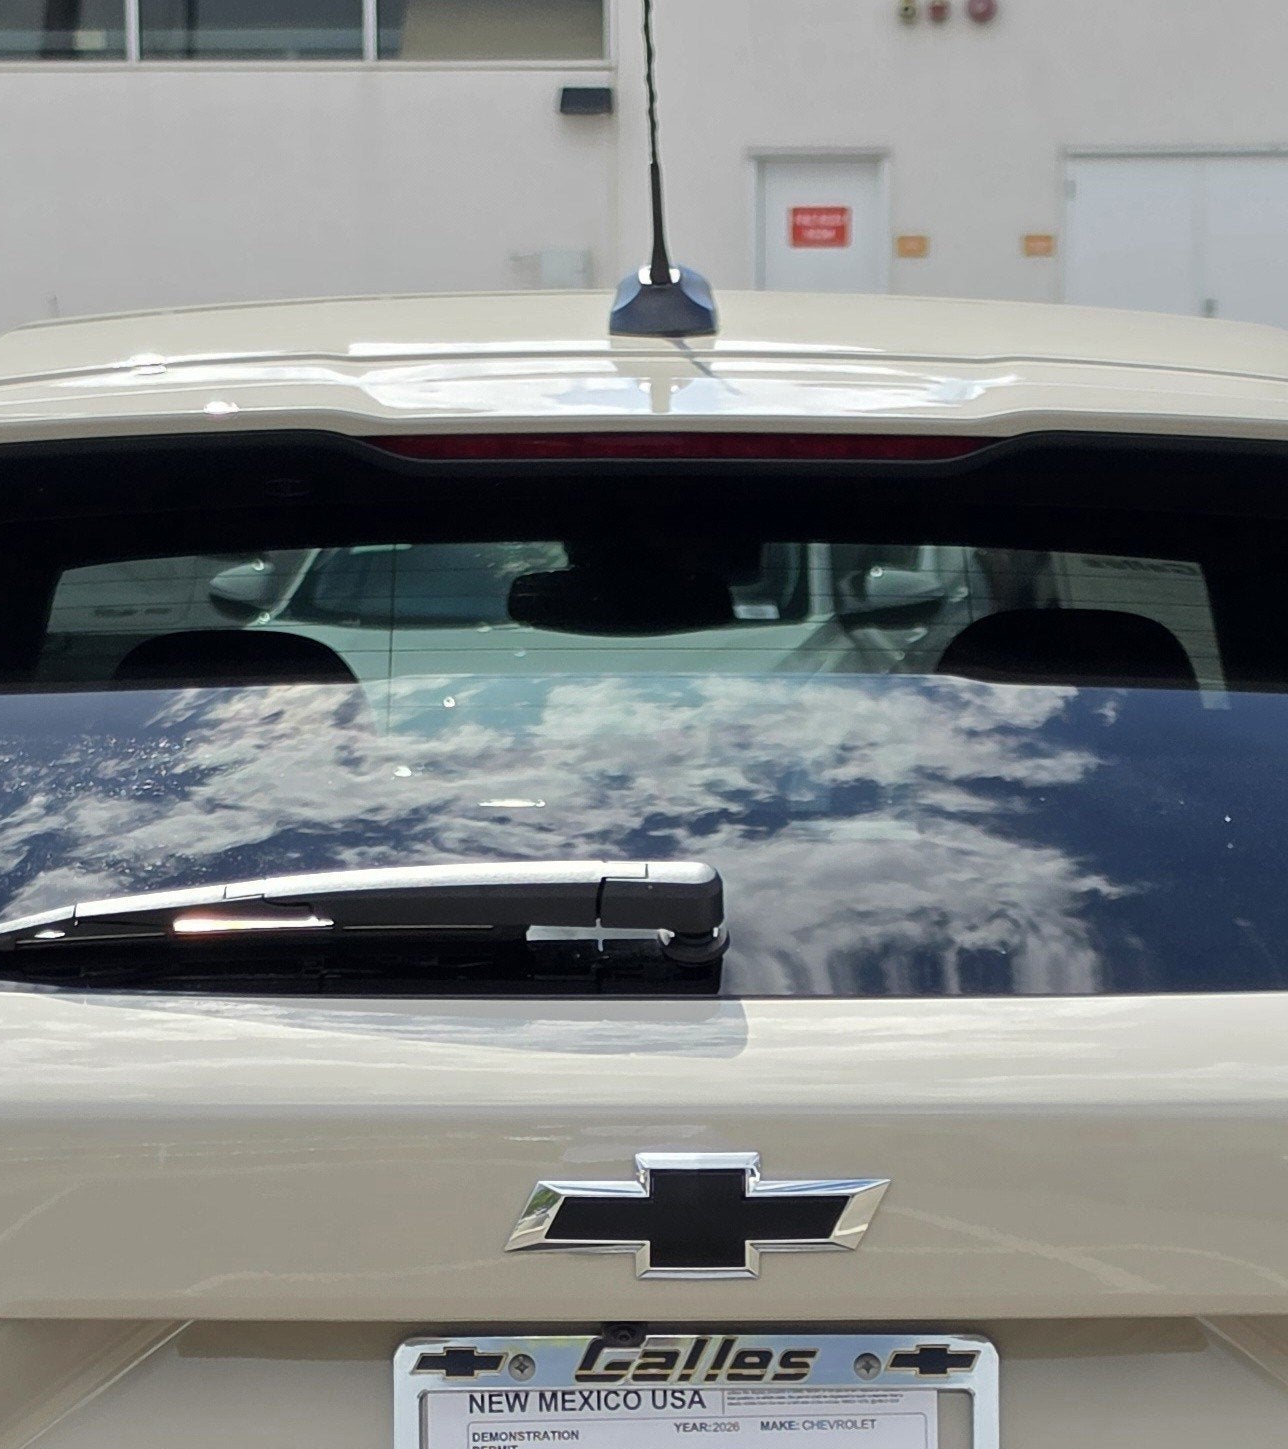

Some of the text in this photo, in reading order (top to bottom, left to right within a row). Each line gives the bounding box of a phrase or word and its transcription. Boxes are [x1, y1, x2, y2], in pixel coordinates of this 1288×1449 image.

[574, 1336, 819, 1383] Galles
[469, 1391, 530, 1414] NEW
[538, 1390, 643, 1413] MEXICO
[651, 1389, 707, 1411] USA
[673, 1421, 711, 1433] YEAR:
[759, 1420, 799, 1432] MAKE:
[801, 1418, 877, 1432] CHEVROLET
[472, 1429, 580, 1443] DEMONSTRATION
